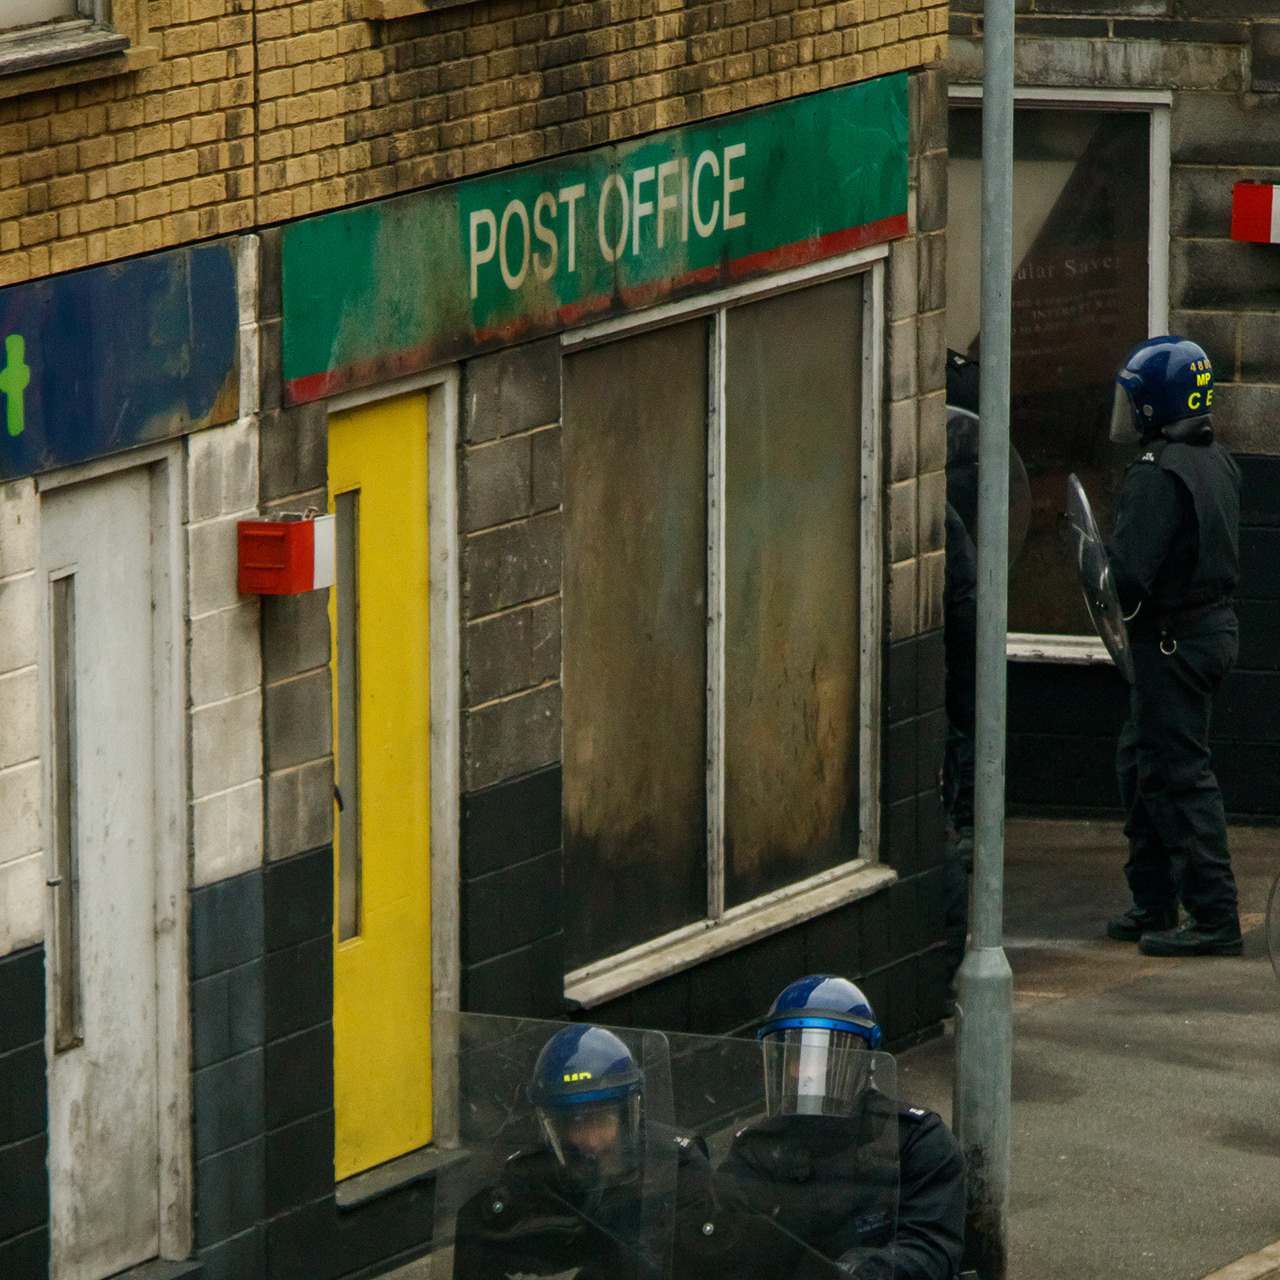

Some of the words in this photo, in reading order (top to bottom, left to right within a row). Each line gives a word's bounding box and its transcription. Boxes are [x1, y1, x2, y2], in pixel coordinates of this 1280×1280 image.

[470, 183, 586, 300] POST
[598, 142, 746, 263] OFFICE
[1012, 262, 1056, 281] ular
[1196, 372, 1211, 387] MP
